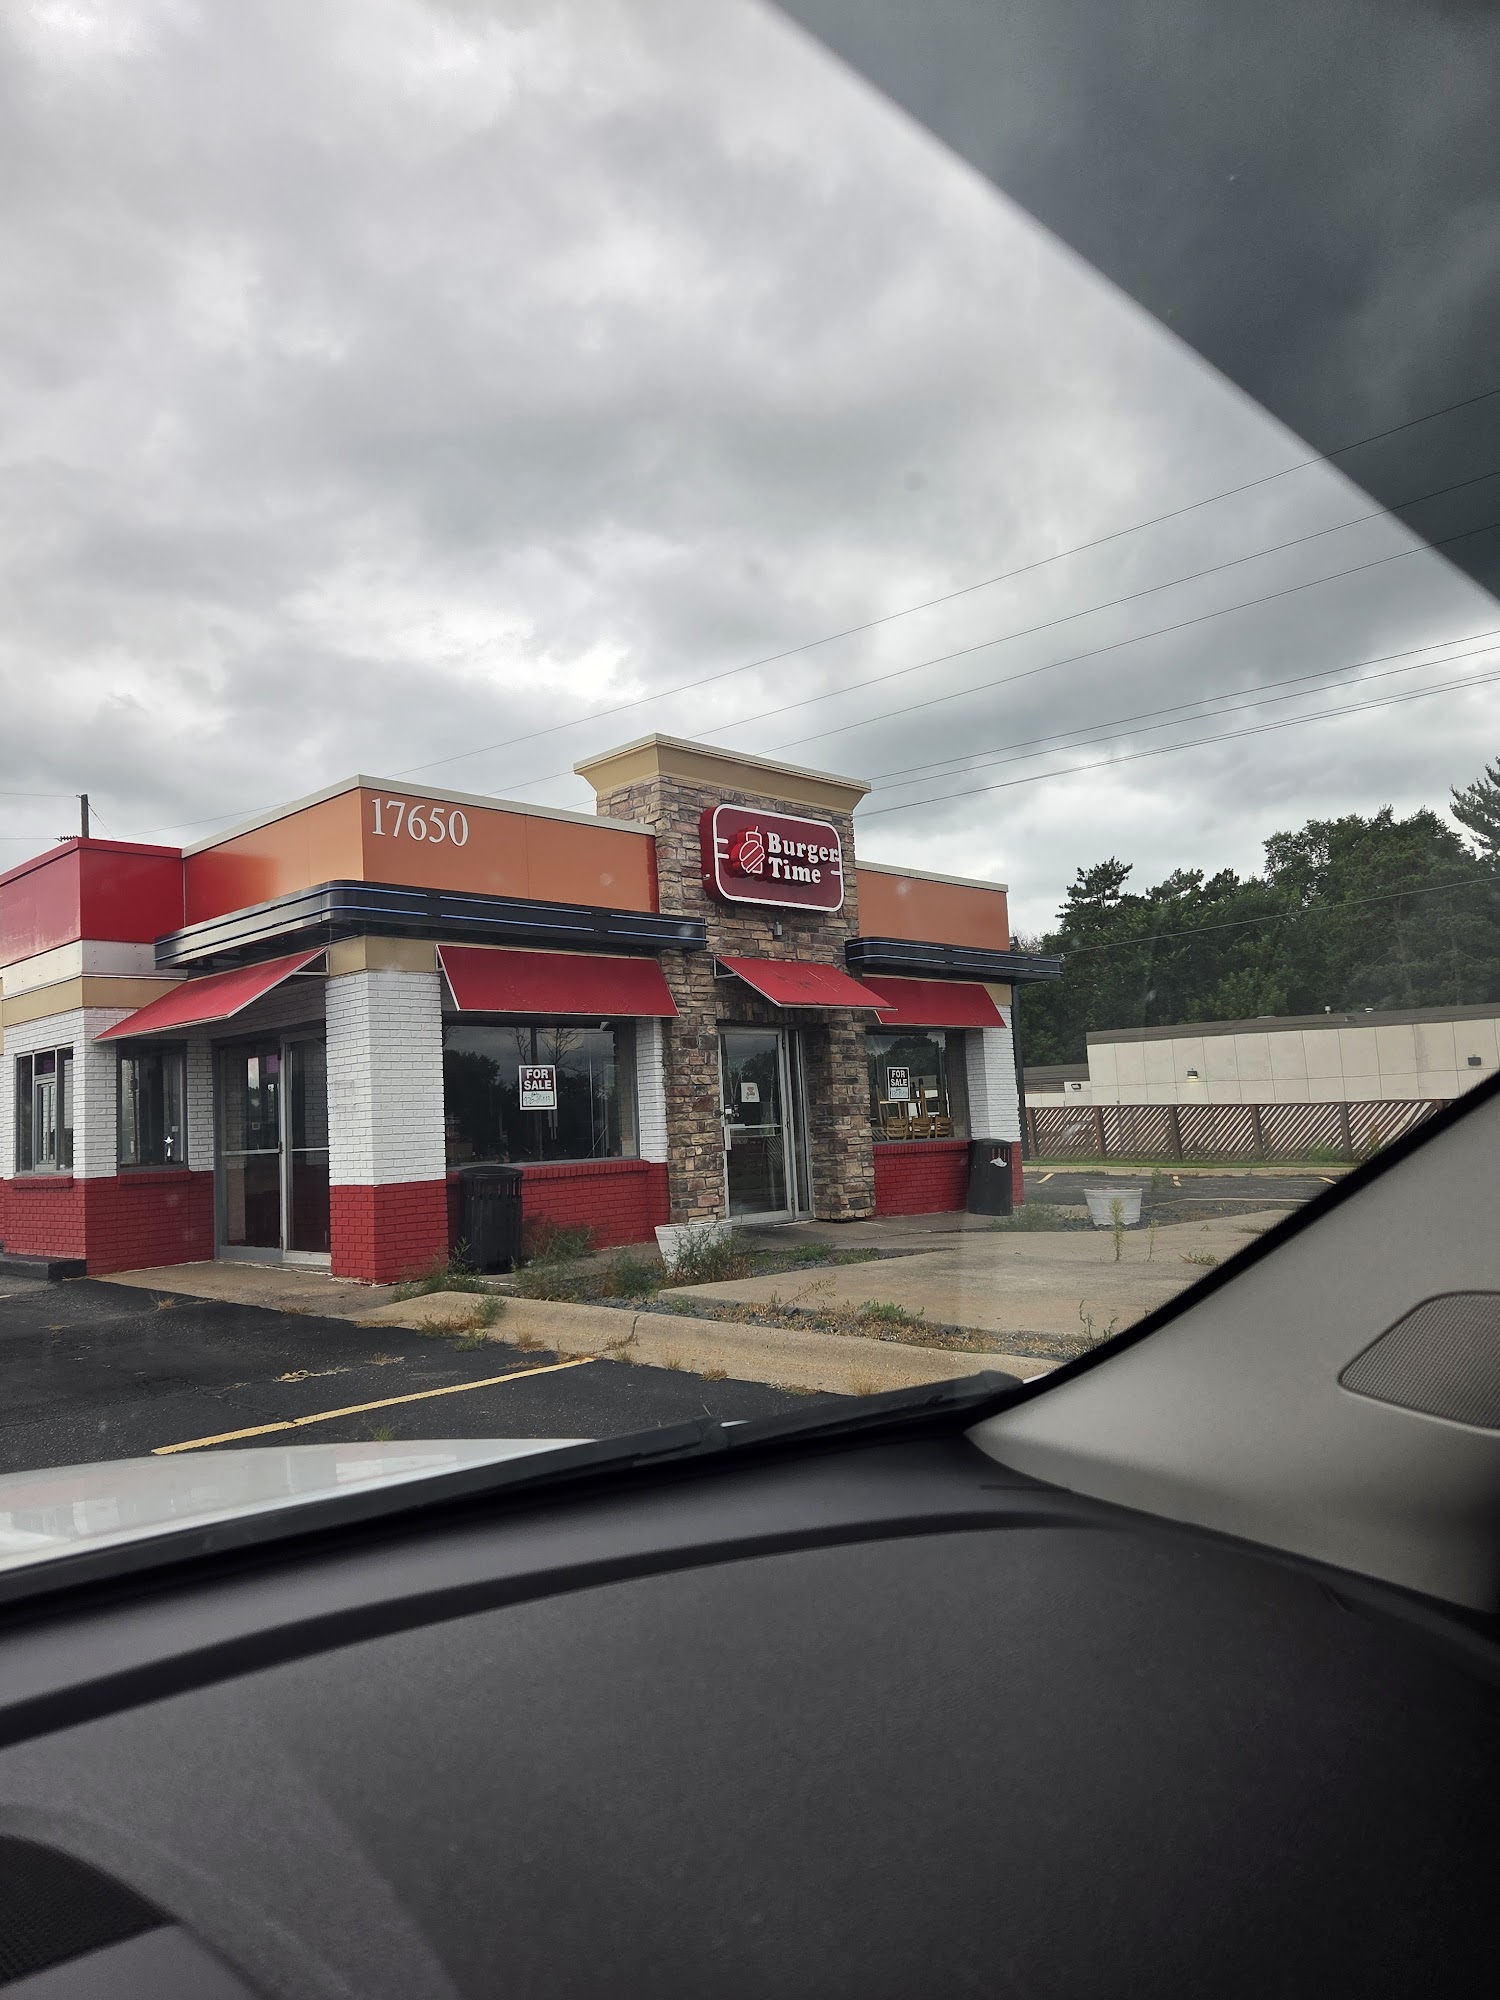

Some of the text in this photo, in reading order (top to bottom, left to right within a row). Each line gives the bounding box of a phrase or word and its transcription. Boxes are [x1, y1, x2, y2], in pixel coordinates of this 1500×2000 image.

[371, 797, 469, 847] 17650
[767, 831, 840, 864] Burger
[768, 856, 821, 884] Time
[526, 1069, 549, 1079] FOR
[891, 1070, 906, 1078] FOR
[523, 1079, 552, 1090] SALE
[890, 1079, 908, 1087] SALE
